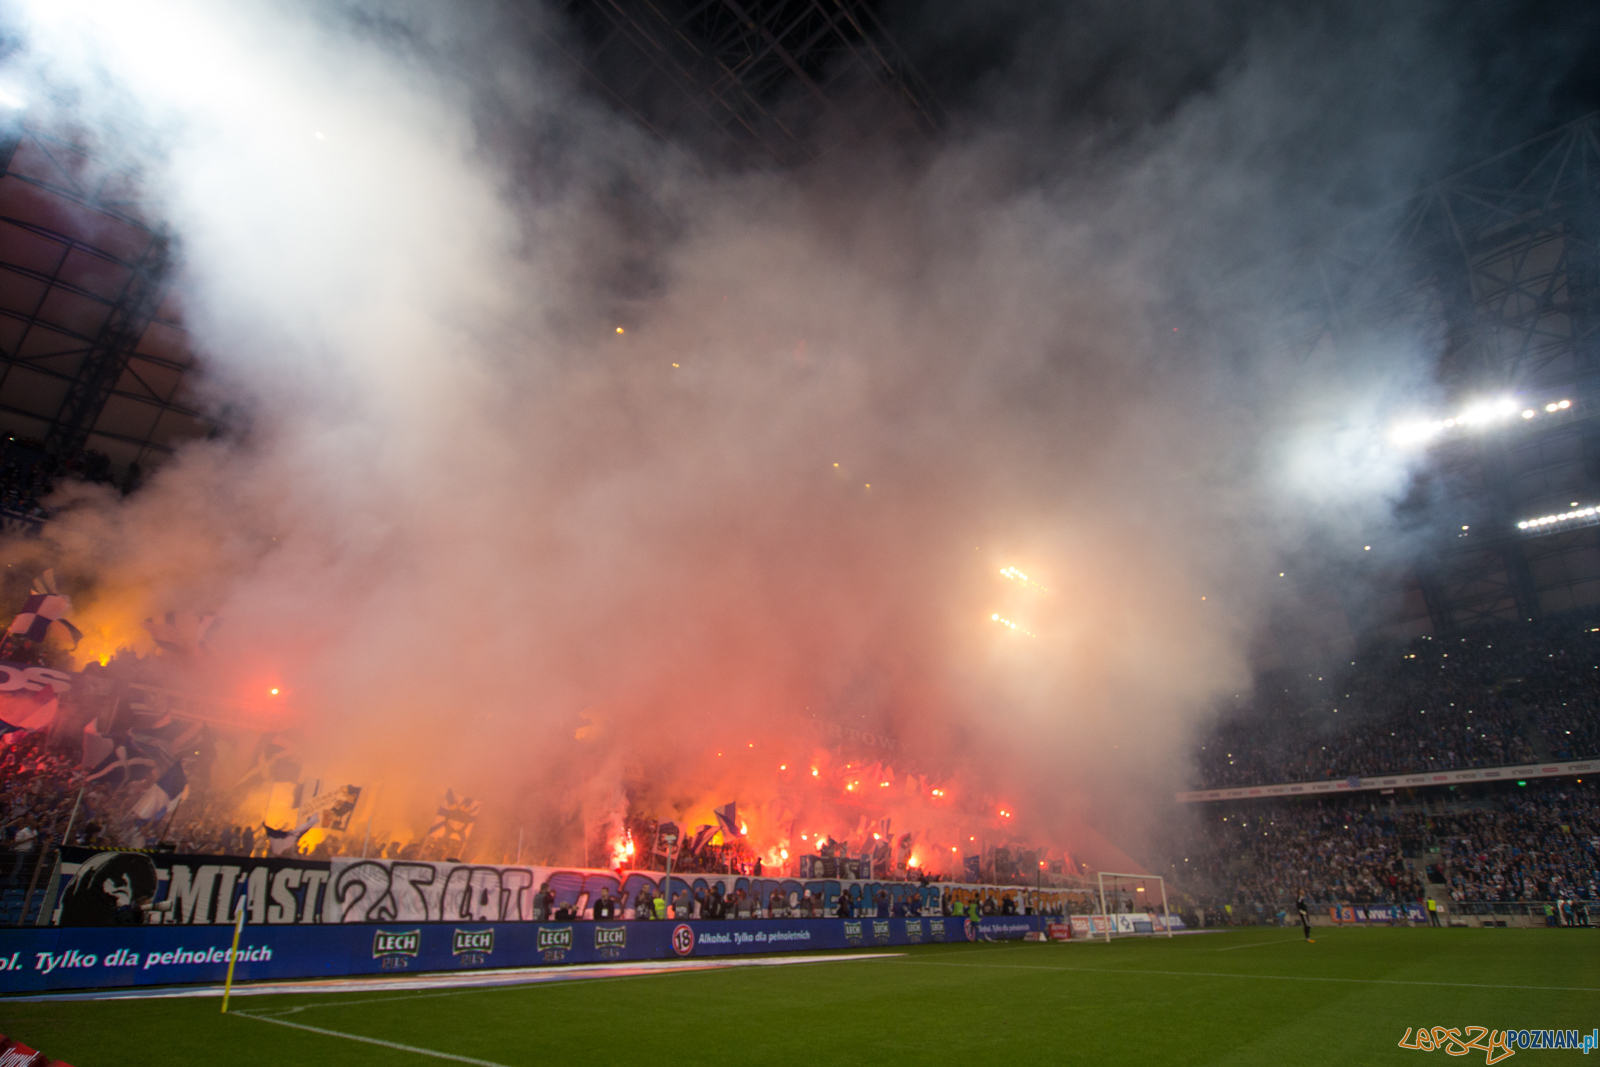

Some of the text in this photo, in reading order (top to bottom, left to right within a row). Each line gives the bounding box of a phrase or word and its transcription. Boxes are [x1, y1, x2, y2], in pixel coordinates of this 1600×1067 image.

[336, 861, 435, 922] 25
[540, 931, 570, 945] LECH
[597, 930, 624, 944] LECH
[698, 933, 732, 945] Alkohol.
[733, 932, 754, 945] Tylko
[755, 931, 767, 943] dla
[845, 925, 861, 935] LECH
[378, 934, 416, 951] LECH
[457, 933, 490, 949] LECH
[674, 929, 691, 950] 18
[34, 948, 98, 976] Tylko
[103, 947, 140, 967] dla
[143, 943, 273, 971] pełnoletnich
